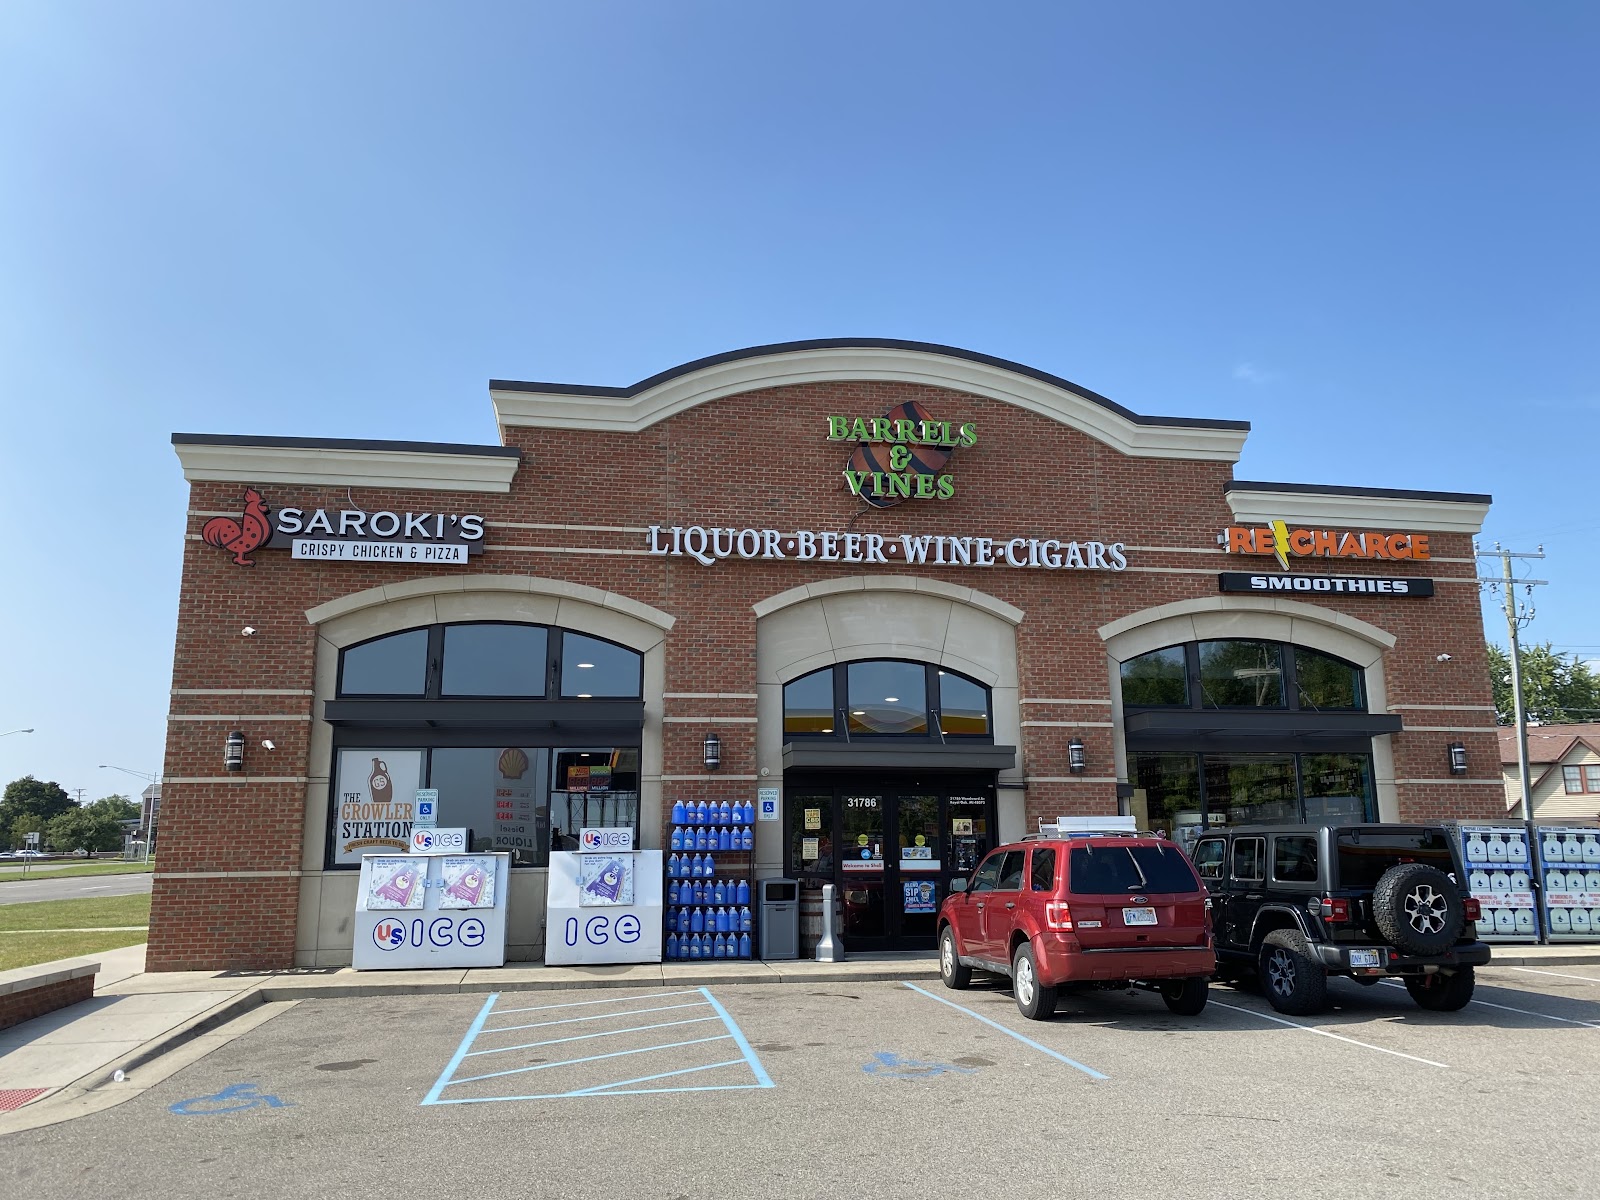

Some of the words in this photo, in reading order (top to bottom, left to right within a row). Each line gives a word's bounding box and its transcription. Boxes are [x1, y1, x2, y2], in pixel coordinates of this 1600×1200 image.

[827, 416, 978, 448] BARRELS
[890, 445, 912, 471] &
[842, 470, 954, 500] VINES
[277, 508, 484, 540] SAROKI'S
[301, 543, 345, 556] CRISPY
[353, 544, 402, 558] CHICKEN
[410, 547, 417, 558] &
[425, 547, 459, 560] PIZZA
[796, 530, 888, 563] BEER
[900, 534, 996, 566] WINE
[1005, 538, 1128, 572] CIGARS
[1250, 576, 1408, 593] SMOOTHIES
[344, 793, 360, 803] THE
[848, 798, 876, 807] 31786
[342, 803, 412, 820] GROWLER
[343, 822, 414, 838] STATION
[906, 888, 919, 896] SIP
